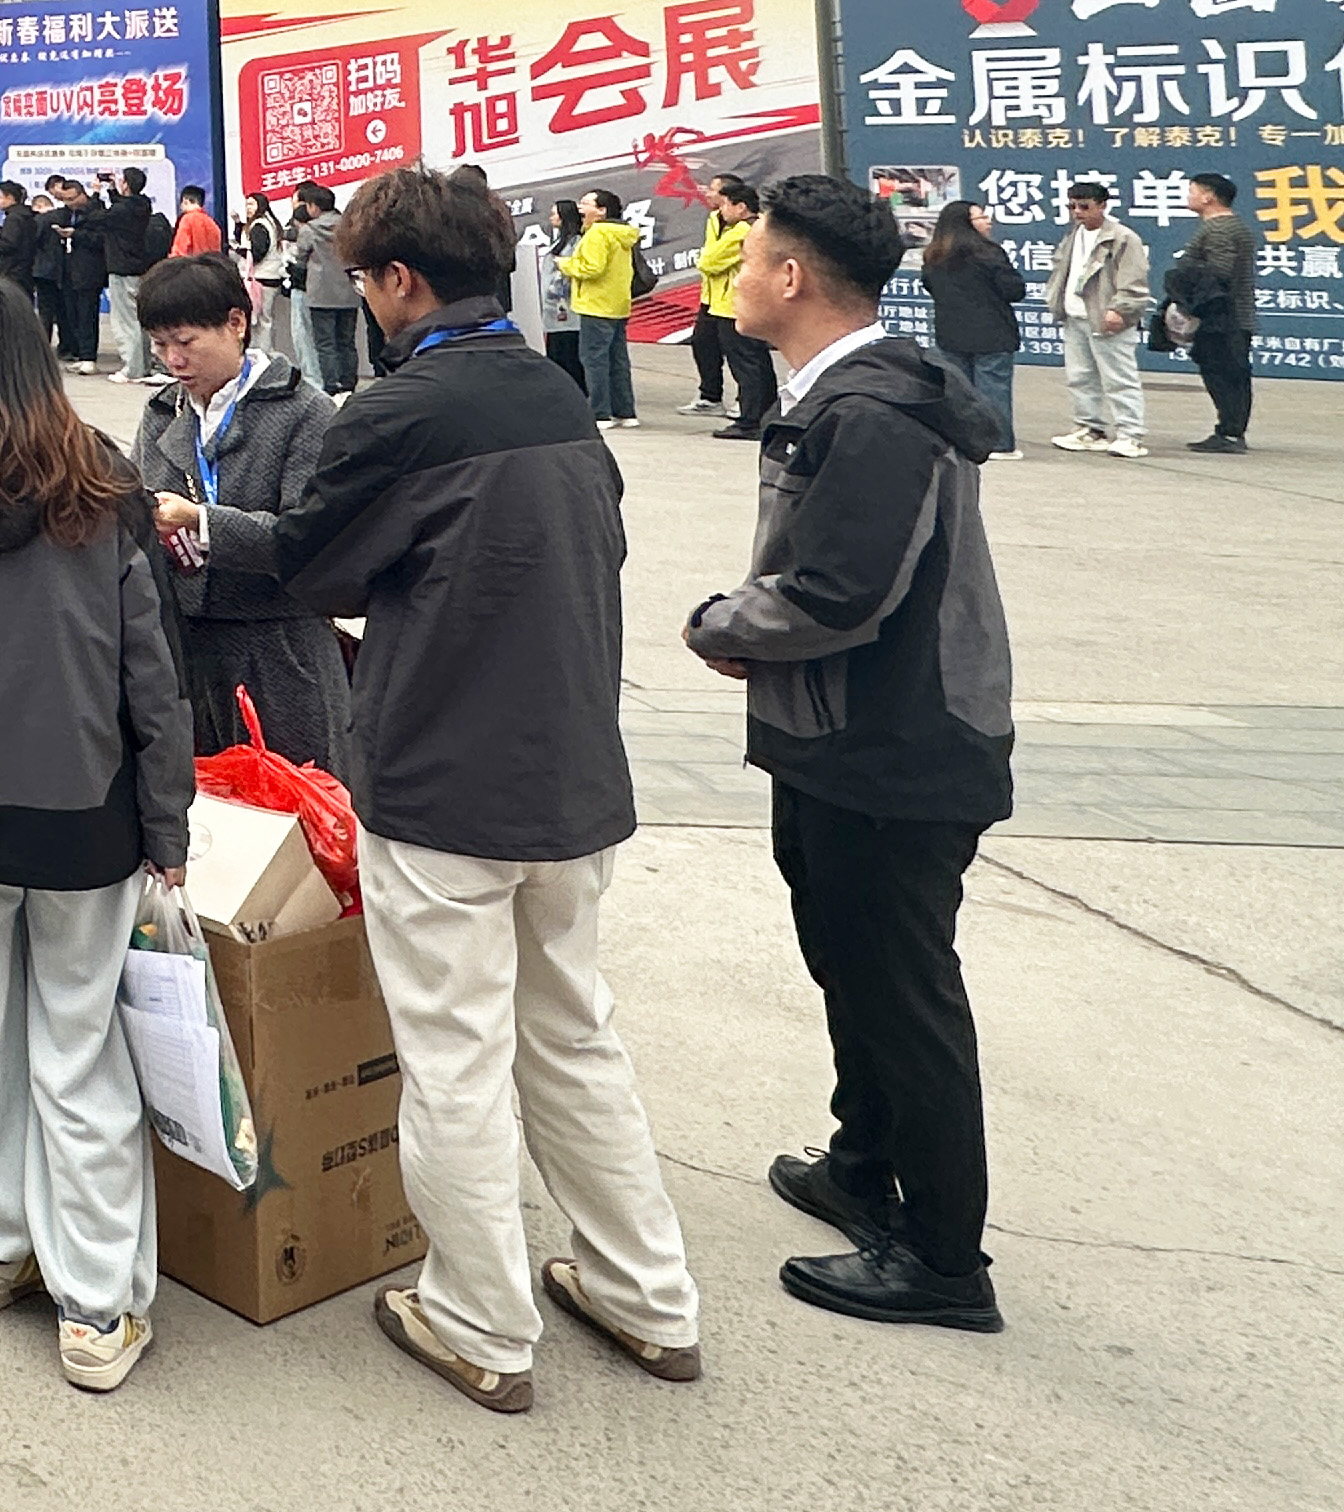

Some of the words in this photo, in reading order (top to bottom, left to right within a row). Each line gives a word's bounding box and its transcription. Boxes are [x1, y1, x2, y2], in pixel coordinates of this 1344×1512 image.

[347, 52, 402, 92] 扫码
[859, 38, 1344, 128] 金属标识
[962, 127, 1085, 150] 认识泰克!
[1104, 125, 1237, 149] 了解泰克!
[1254, 165, 1344, 244] 我
[1256, 244, 1344, 278] 共赢
